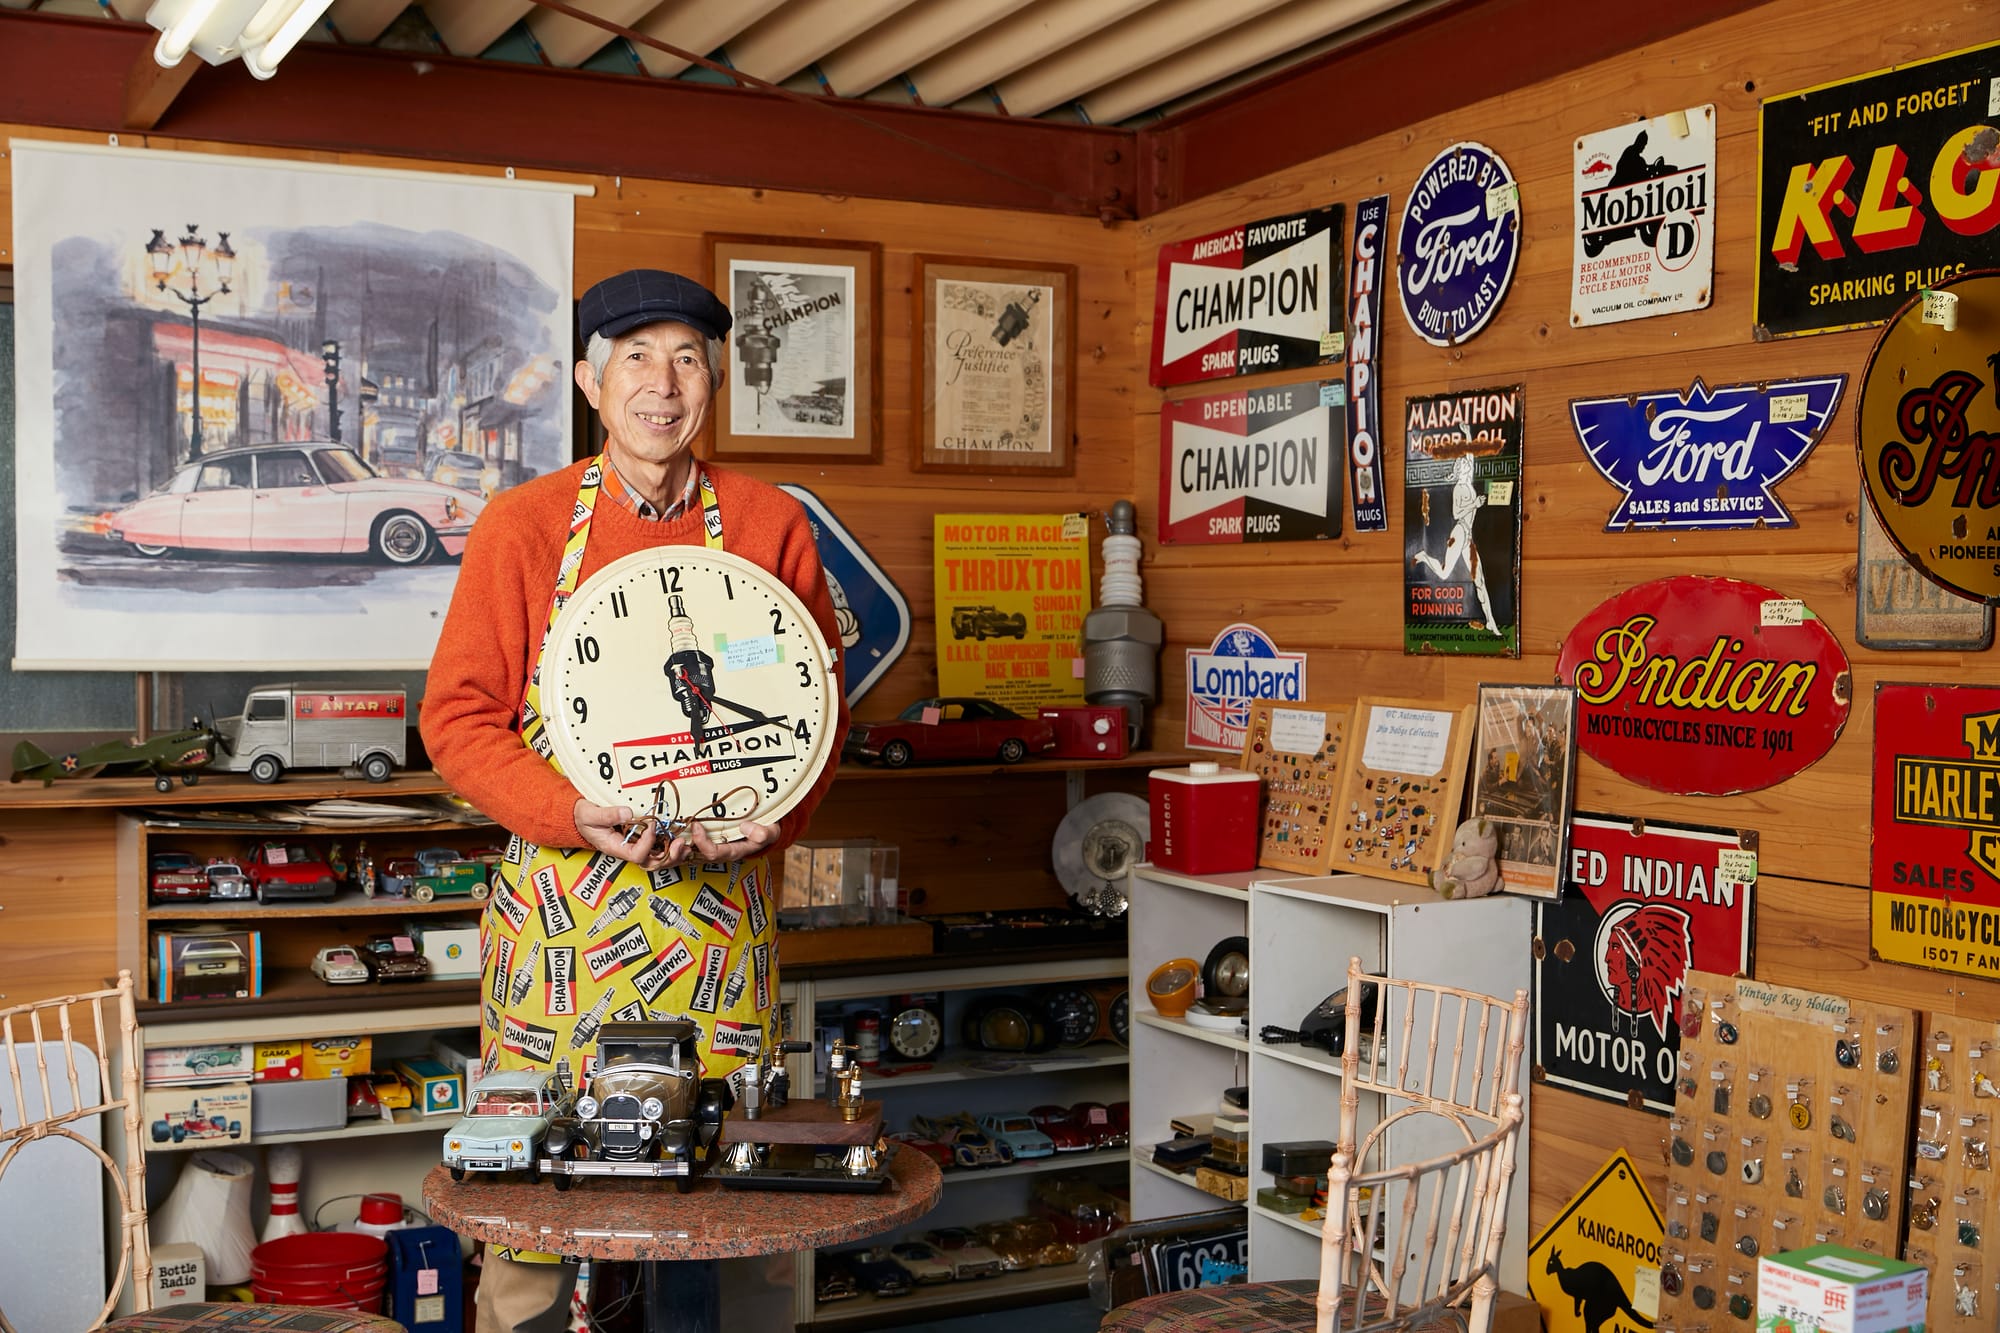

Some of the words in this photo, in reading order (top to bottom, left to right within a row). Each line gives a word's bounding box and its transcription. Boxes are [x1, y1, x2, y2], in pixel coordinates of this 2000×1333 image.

[1848, 102, 1888, 129] AND
[1410, 154, 1478, 224] POWERED
[1478, 162, 1500, 191] BY
[1581, 171, 1707, 231] Mobiloil
[1362, 207, 1379, 221] USE
[1193, 230, 1244, 261] AMERICA'S
[1248, 218, 1306, 247] FAVORITE
[1408, 205, 1505, 296] Ford
[1580, 272, 1598, 284] FOR
[1600, 269, 1616, 281] ALL
[1619, 263, 1652, 277] MOTOR
[1581, 251, 1650, 273] RECOMMENDED
[1175, 264, 1318, 333] CHAMPION
[1579, 282, 1607, 295] CYCLE
[1610, 275, 1649, 291] ENGINES
[1809, 274, 1895, 306] SPARKING
[763, 293, 841, 330] CHAMPION
[1418, 300, 1447, 334] BUILT
[1451, 310, 1467, 331] TO
[1468, 274, 1498, 318] LAST
[1592, 304, 1622, 314] VACUUM
[1624, 301, 1634, 310] OIL
[1637, 295, 1672, 307] COMPANY
[1201, 348, 1235, 372] SPARK
[1239, 345, 1279, 368] PLUGS
[1351, 224, 1378, 504] CHAMPION
[1204, 392, 1292, 420] DEPENDABLE
[1407, 393, 1516, 431] MARATHON
[943, 436, 1034, 450] CHAMPION
[1638, 403, 1762, 486] Ford
[1180, 437, 1317, 493] CHAMPION
[1357, 509, 1382, 522] PLUGS
[1629, 500, 1670, 514] SALES
[1674, 499, 1699, 513] and
[1703, 496, 1764, 512] SERVICE
[944, 525, 1010, 542] MOTOR
[1016, 525, 1081, 542] RACI
[1208, 518, 1242, 535] SPARK
[1246, 515, 1281, 534] PLUGS
[659, 566, 684, 594] 12
[724, 574, 734, 600] 1
[944, 559, 1082, 591] THRUXTON
[610, 591, 629, 618] 11
[1033, 595, 1081, 612] SUNDAY
[1411, 588, 1432, 600] FOR
[1434, 587, 1464, 599] GOOD
[769, 609, 786, 635] 2
[1036, 615, 1057, 630] OCT.
[1411, 603, 1463, 616] RUNNING
[575, 635, 600, 665] 10
[987, 643, 1050, 660] CHAMPIONSHIP
[795, 661, 812, 688] 3
[985, 662, 1007, 680] RACE
[1011, 662, 1049, 678] MEETING
[1192, 657, 1299, 701] Lombard
[1575, 614, 1818, 718] Indian
[320, 701, 379, 712] ANTAR
[572, 696, 588, 723] 9
[793, 718, 812, 745] 4
[1587, 713, 1701, 744] MOTORCYCLES
[1705, 723, 1756, 749] SINCE
[1761, 728, 1794, 759] 1901
[629, 732, 782, 770] CHAMPION
[597, 752, 614, 780] 8
[678, 763, 709, 777] SPARK
[712, 759, 742, 771] PLUGS
[763, 767, 778, 794] 5
[1904, 765, 2000, 822] HARLE
[651, 786, 666, 814] 7
[712, 792, 727, 818] 6
[581, 856, 616, 901] CHAMPIO
[1571, 848, 1608, 886] ED
[1624, 855, 1735, 908] INDIAN
[1893, 862, 1975, 893] SALES
[539, 872, 566, 932] CHAMPION
[696, 894, 737, 929] CHAMPION
[745, 874, 764, 930] CHAMPION
[591, 934, 645, 971] CHAMPION
[1923, 946, 1958, 964] 1507
[498, 940, 509, 1001] CHAMPION
[554, 950, 566, 1012] CHAMPION
[640, 949, 687, 995] CHAMPION
[700, 949, 721, 1009] CHAMPION
[1739, 985, 1778, 1006] Vintage
[1781, 993, 1802, 1012] Key
[1806, 995, 1847, 1015] Holders
[261, 1049, 290, 1058] GAMA
[505, 1027, 552, 1052] CHAMPION
[716, 1031, 760, 1048] CHAMPION
[1556, 1022, 1647, 1080] MOTOR
[158, 1263, 197, 1278] Bottle
[160, 1275, 197, 1289] Radio
